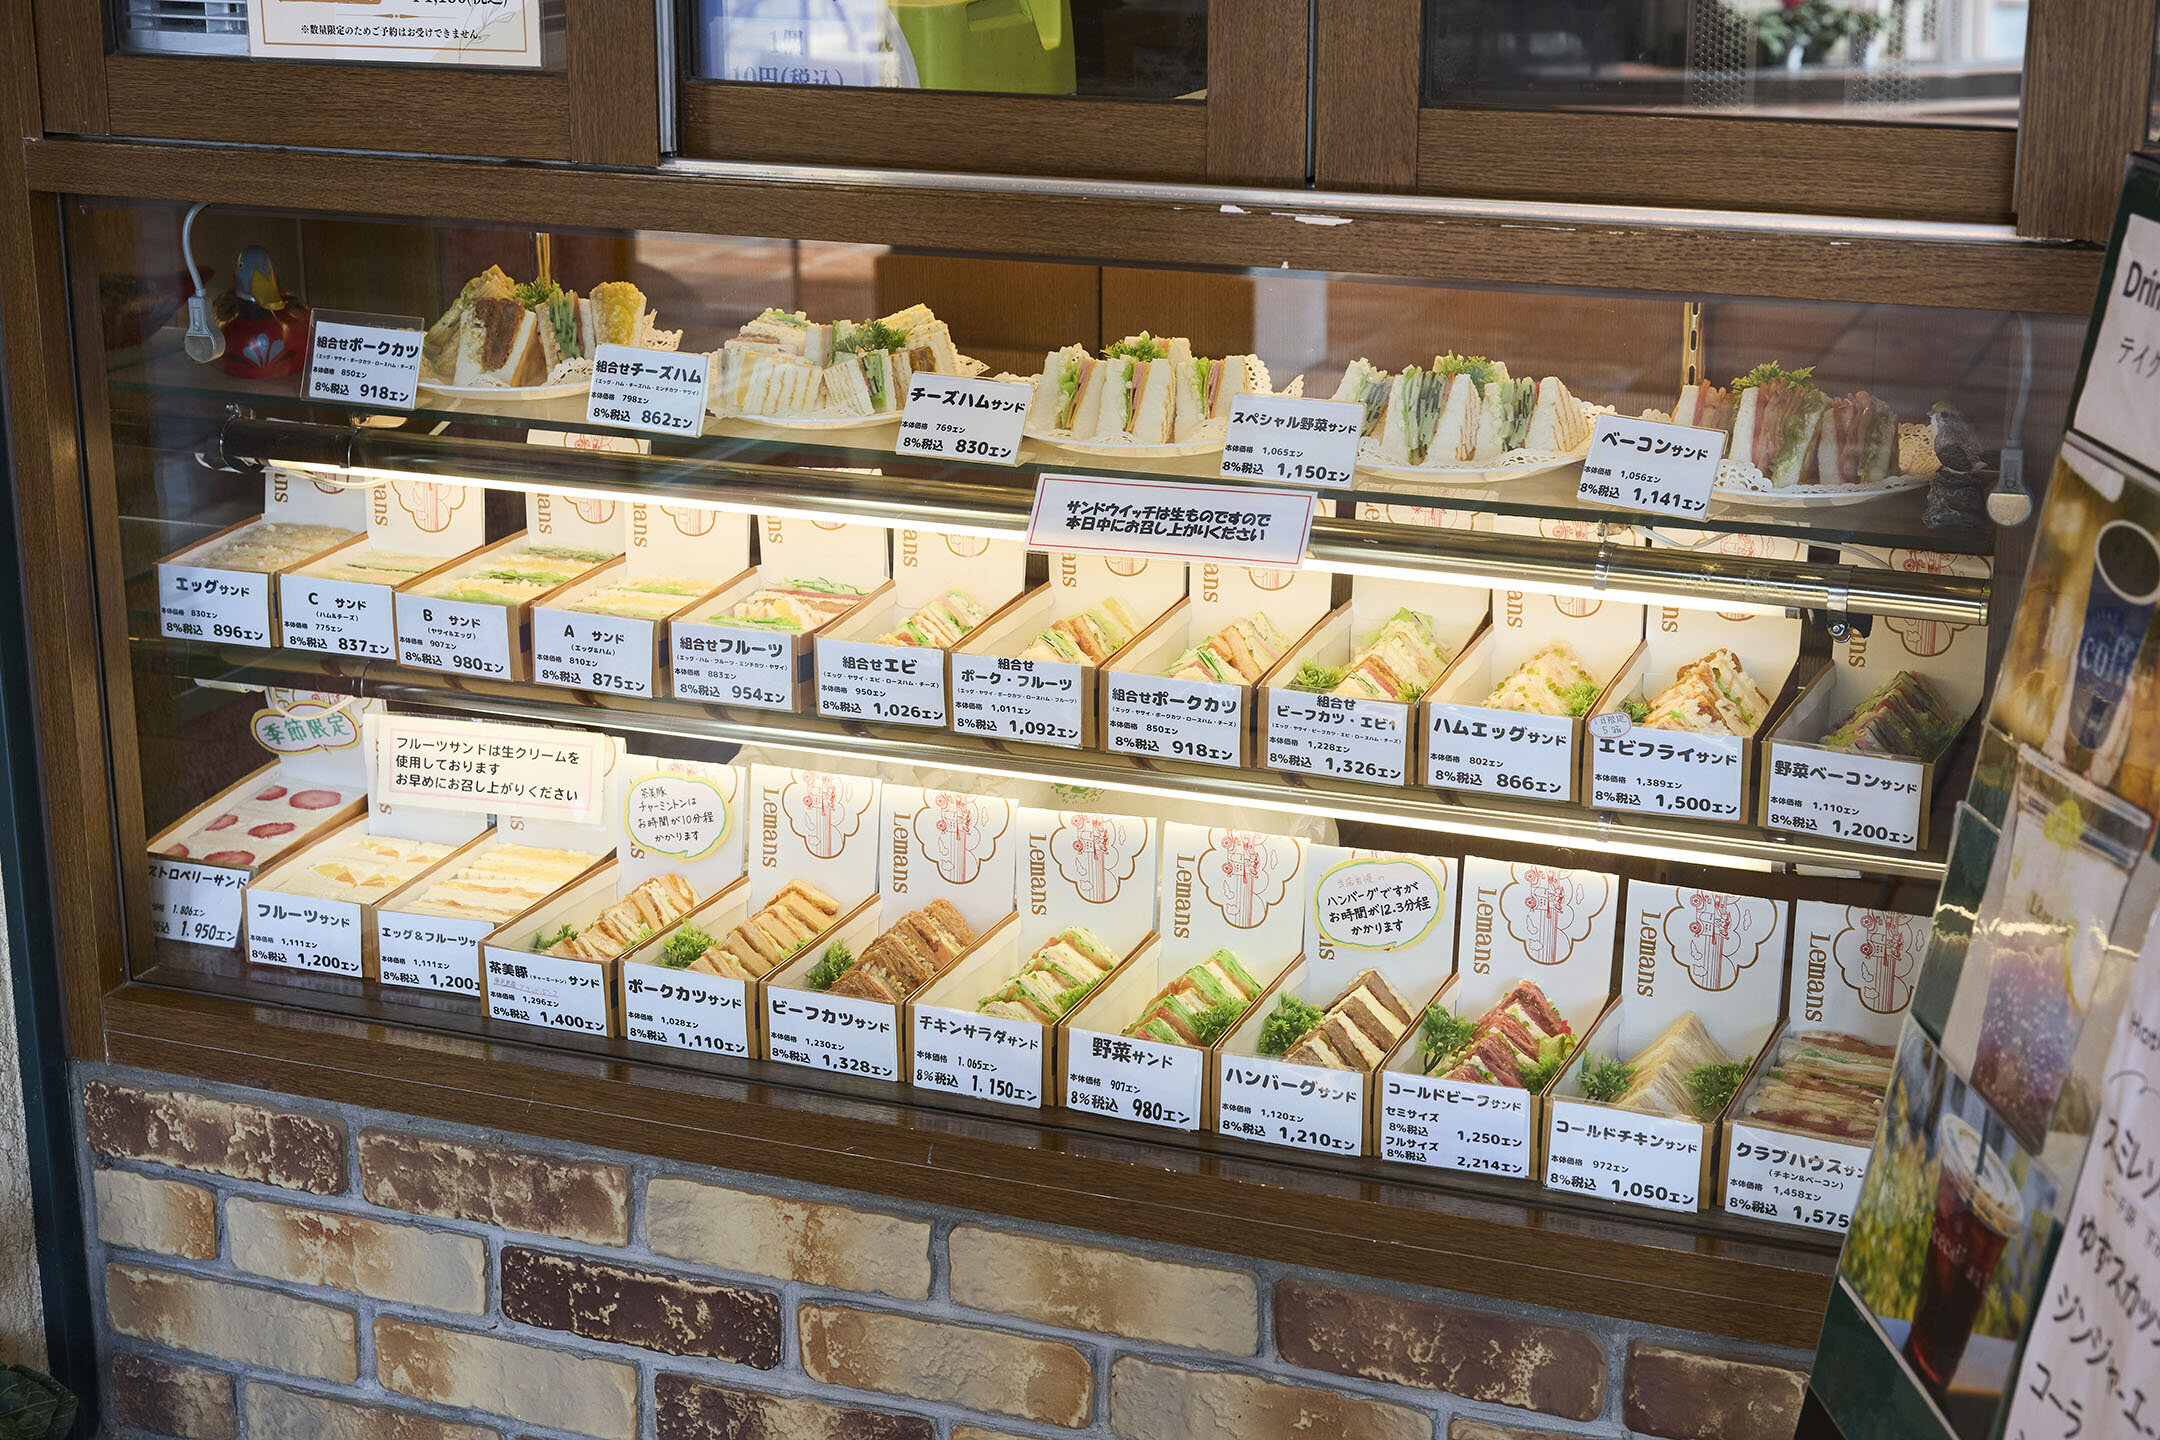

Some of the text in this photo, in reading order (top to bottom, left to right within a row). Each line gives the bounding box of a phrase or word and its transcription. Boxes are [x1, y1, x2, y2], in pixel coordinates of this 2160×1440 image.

[317, 336, 419, 358] 組合せポークカツ
[341, 369, 367, 378] 850エン
[596, 360, 701, 383] 組合せチーズハム
[360, 384, 408, 401] 918エン
[622, 395, 649, 404] 798エン
[911, 387, 1025, 413] チーズハムサンド
[594, 408, 692, 428] 8%税込 862エン
[936, 424, 965, 433] 769エン
[1233, 412, 1357, 434] スペシャル野菜サンド
[956, 439, 1011, 457] 830エン
[1262, 447, 1303, 457] 1,065エン
[1602, 432, 1708, 460] ベーコンサンド
[1222, 461, 1350, 482] 8%税込 1,150エン
[1620, 470, 1661, 483] 1,056エン
[1634, 488, 1705, 511] 1,141エン
[1067, 500, 1271, 527] サンドウイッチは生ものですので
[1065, 515, 1265, 542] 本日中にお召し上がりください
[176, 577, 250, 597] エッグサンド
[308, 592, 366, 610] C サンド
[191, 609, 218, 619] 830エン
[423, 608, 481, 628] B サンド
[166, 622, 263, 640] 8%税込 896エン
[315, 623, 343, 632] 775エン
[564, 625, 625, 644] A サンド
[338, 637, 389, 654] 837エン
[430, 639, 457, 650] 907エン
[679, 636, 783, 658] 組合せフルーツ
[405, 651, 504, 673] 8%税込 980エン
[569, 657, 598, 668] 810エン
[842, 655, 918, 675] 組合せエビ
[998, 658, 1034, 672] 組合せ
[592, 672, 645, 692] 875エン
[708, 670, 737, 680] 883エン
[961, 669, 1072, 692] ポーク・フルーツ
[680, 684, 786, 704] 8%税込 954エン
[855, 687, 887, 697] 950エン
[1112, 688, 1237, 714] 組合せポークカツ
[1316, 695, 1356, 710] 組合せ
[873, 702, 944, 720] 1,026エン
[991, 704, 1031, 715] 1,011エン
[263, 713, 350, 745] 季節限定
[957, 718, 1078, 739] 8%税込 1,092エン
[1146, 723, 1178, 735] 850エン
[1434, 717, 1567, 747] ハムエッグサンド
[396, 737, 580, 765] フルーツサンドは生クリームを
[1172, 740, 1232, 761] 918エン
[1308, 741, 1350, 753] 1,228エン
[1599, 738, 1737, 766] エビフライサンド
[396, 755, 500, 775] 使用しております
[1270, 753, 1401, 778] 8%税込 1,326エン
[1469, 757, 1504, 768] 802エン
[1496, 773, 1561, 793] 866エン
[1636, 777, 1683, 790] 1,389エン
[1774, 759, 1918, 794] 野菜ベーコンサンド
[395, 774, 578, 801] お早めにお召し上がりください
[1595, 790, 1737, 815] 8%税込 1,500エン
[1812, 801, 1860, 816] 1,110エン
[655, 830, 699, 843] かかります
[762, 785, 779, 868] Lemans
[1832, 819, 1915, 844] 1,200エン
[893, 810, 911, 894] Lemans
[1029, 832, 1047, 916] Lemans
[1174, 852, 1195, 939] Lemans
[1327, 881, 1419, 907] ハンバーグですが
[258, 903, 350, 928] フルーツサンド
[1351, 919, 1403, 936] かかります
[1472, 886, 1497, 975] Lemans
[281, 938, 317, 948] 1,111エン
[1636, 908, 1661, 998] Lemans
[252, 949, 359, 972] 8%税込 1,200エン
[413, 959, 450, 970] 1,111エン
[1805, 930, 1830, 1023] Lemans
[523, 996, 559, 1007] 1,296エン
[628, 979, 741, 1009] ポークカツサンド
[493, 1006, 604, 1031] 8%税込 1,400エン
[661, 1016, 699, 1029] 1,028エン
[772, 1000, 890, 1033] ビーフカツサンド
[678, 1032, 745, 1053] 1,110エン
[920, 1016, 1038, 1050] チキンサラダサンド
[805, 1038, 845, 1050] 1,230エン
[1092, 1036, 1173, 1069] 野菜サンド
[772, 1048, 893, 1077] 8%税込 1,328エン
[916, 1050, 948, 1064] 本体価格
[1070, 1073, 1141, 1094] 本体価格 907エン
[1225, 1068, 1357, 1103] ハンバーグサンド
[1388, 1082, 1522, 1111] コールドビーフサンド
[1071, 1091, 1190, 1124] 8%税込 980エン
[1222, 1103, 1304, 1122] 本体価格 1,120エン
[1385, 1105, 1440, 1122] セミサイズ
[1279, 1126, 1355, 1150] 1,210エン
[1385, 1136, 1439, 1152] フルサイズ
[1389, 1122, 1522, 1147] 8%税込 1,250エン
[1556, 1120, 1698, 1154] コールドチキンサンド
[1386, 1149, 1522, 1173] 8%税込 2,214エン
[1551, 1155, 1629, 1173] 本体価格 972エン
[1550, 1173, 1694, 1205] 8%税込 1,050エン
[1730, 1178, 1822, 1201] 本体価格 1,458エン
[1729, 1197, 1778, 1216] 8%税込
